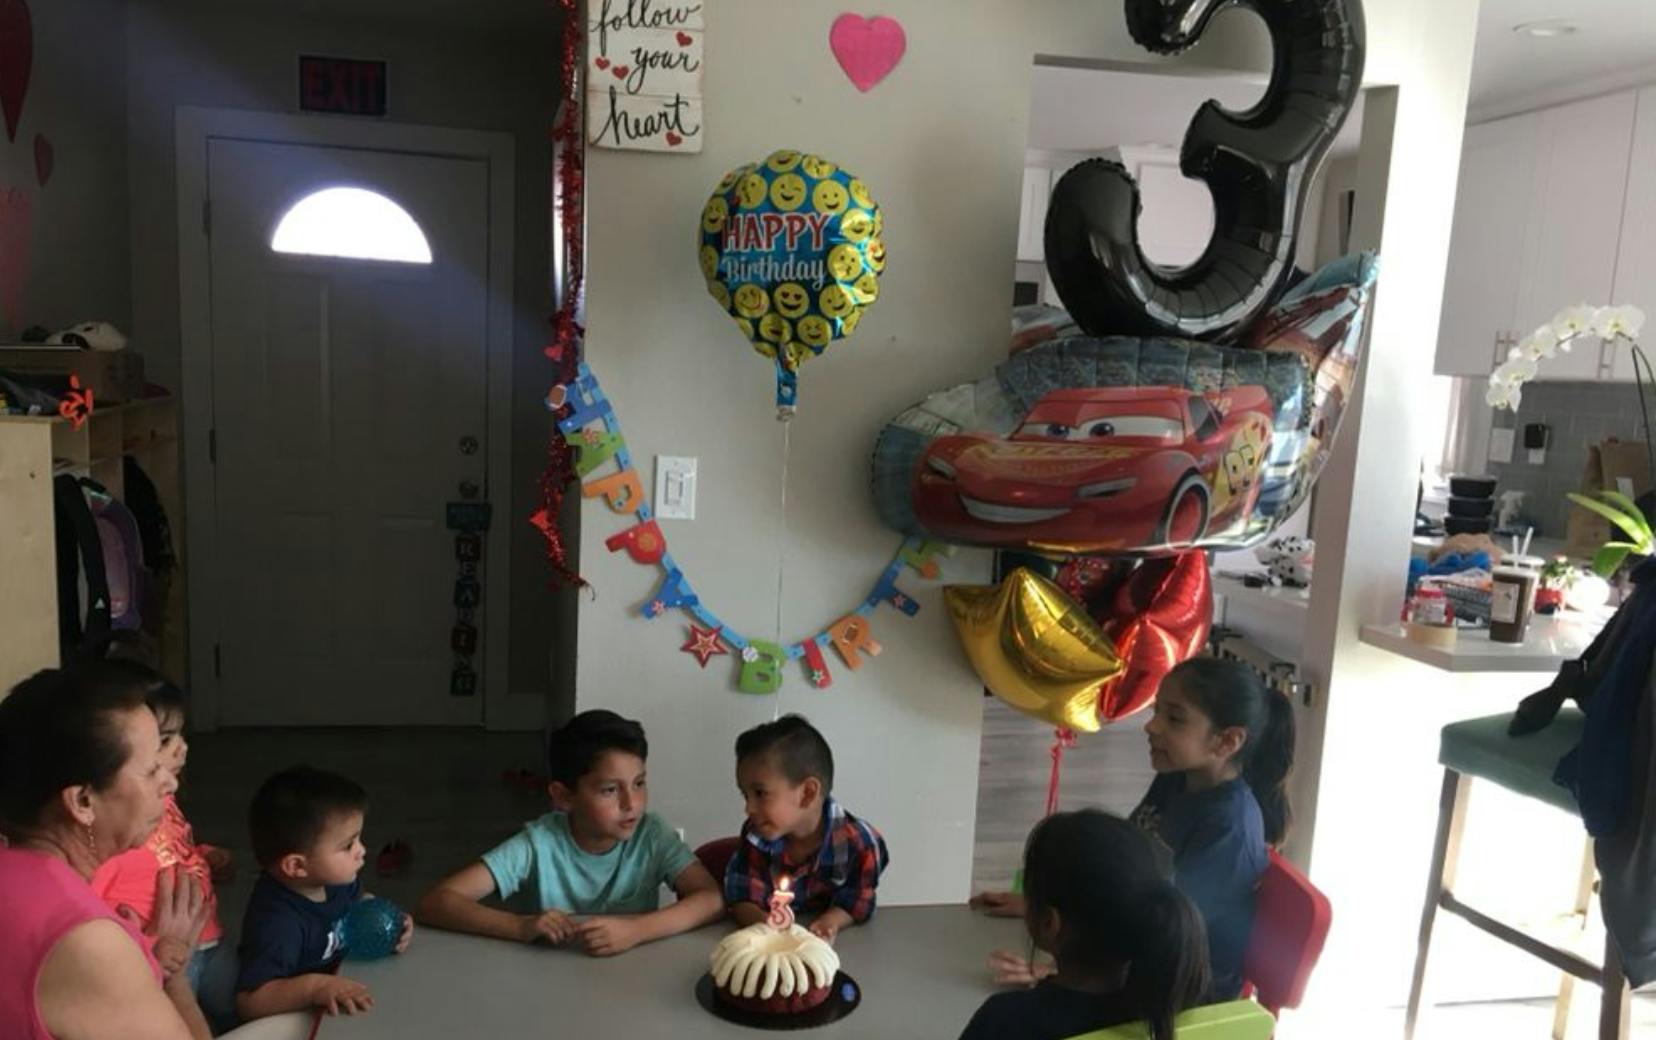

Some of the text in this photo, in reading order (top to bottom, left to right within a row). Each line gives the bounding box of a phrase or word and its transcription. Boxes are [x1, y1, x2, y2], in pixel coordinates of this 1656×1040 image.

[590, 0, 701, 56] follow
[303, 61, 383, 112] EXIT
[627, 46, 700, 95] your
[592, 85, 700, 147] heart
[720, 212, 832, 252] HAPPY
[720, 254, 827, 289] Birthday
